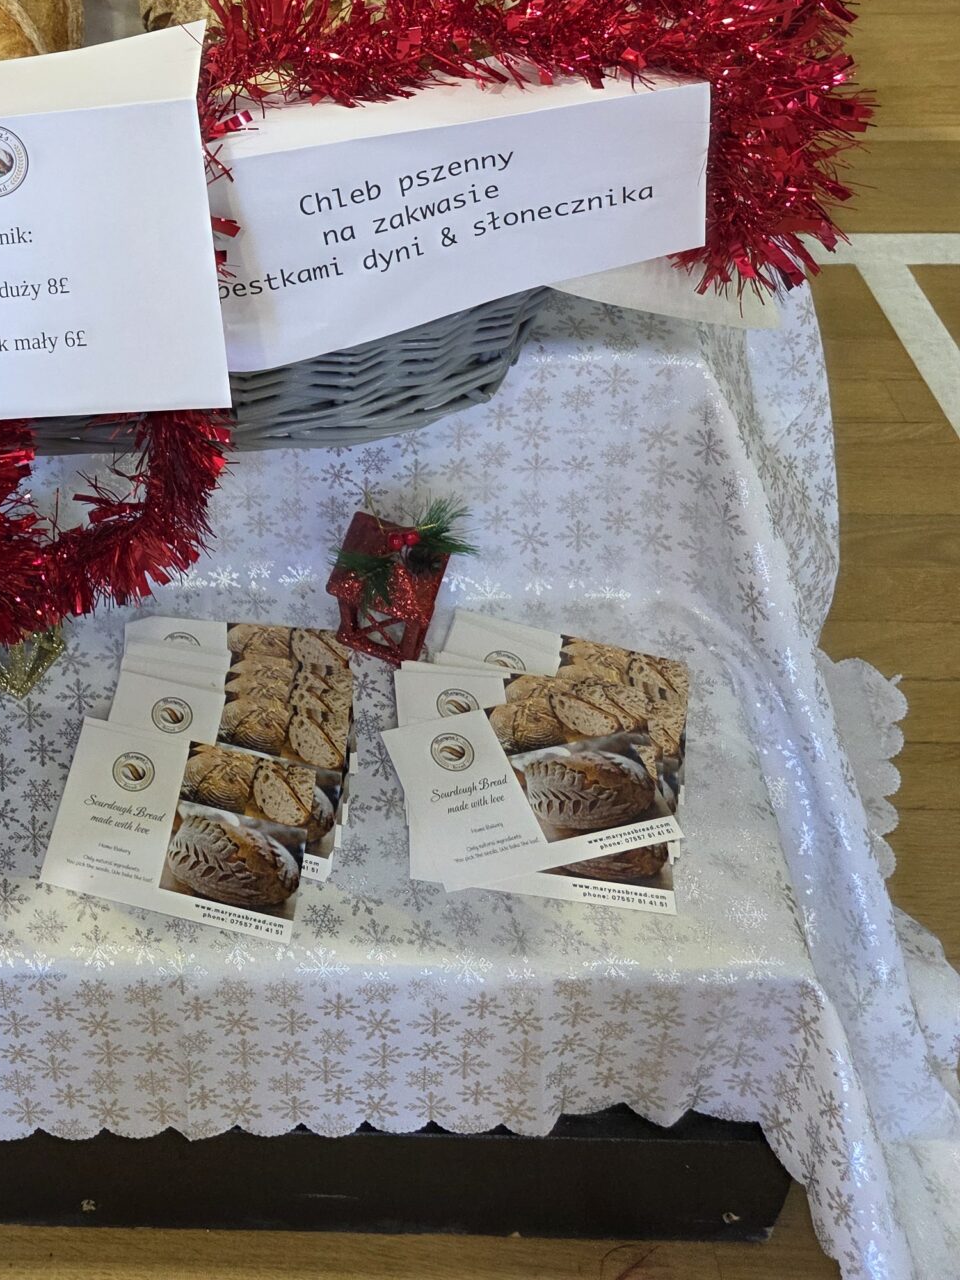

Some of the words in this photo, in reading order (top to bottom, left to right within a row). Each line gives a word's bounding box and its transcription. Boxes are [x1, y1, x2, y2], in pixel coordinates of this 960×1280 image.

[298, 180, 382, 216] Chleb
[397, 150, 515, 197] pszenny
[323, 225, 357, 247] na
[371, 183, 500, 235] zakwasie
[362, 241, 425, 273] dyni
[440, 227, 459, 248] &
[472, 184, 655, 237] słonecznika
[47, 277, 71, 294] 8£
[14, 332, 59, 354] mały
[64, 330, 88, 348] 6£
[430, 782, 477, 802] Sourdough
[478, 774, 508, 791] Bread
[83, 794, 133, 815] Sourdough
[133, 806, 166, 822] Bread
[447, 801, 469, 814] made
[470, 795, 488, 808] with
[490, 794, 505, 804] love
[90, 815, 113, 826] made
[114, 821, 133, 831] with
[134, 823, 151, 835] love
